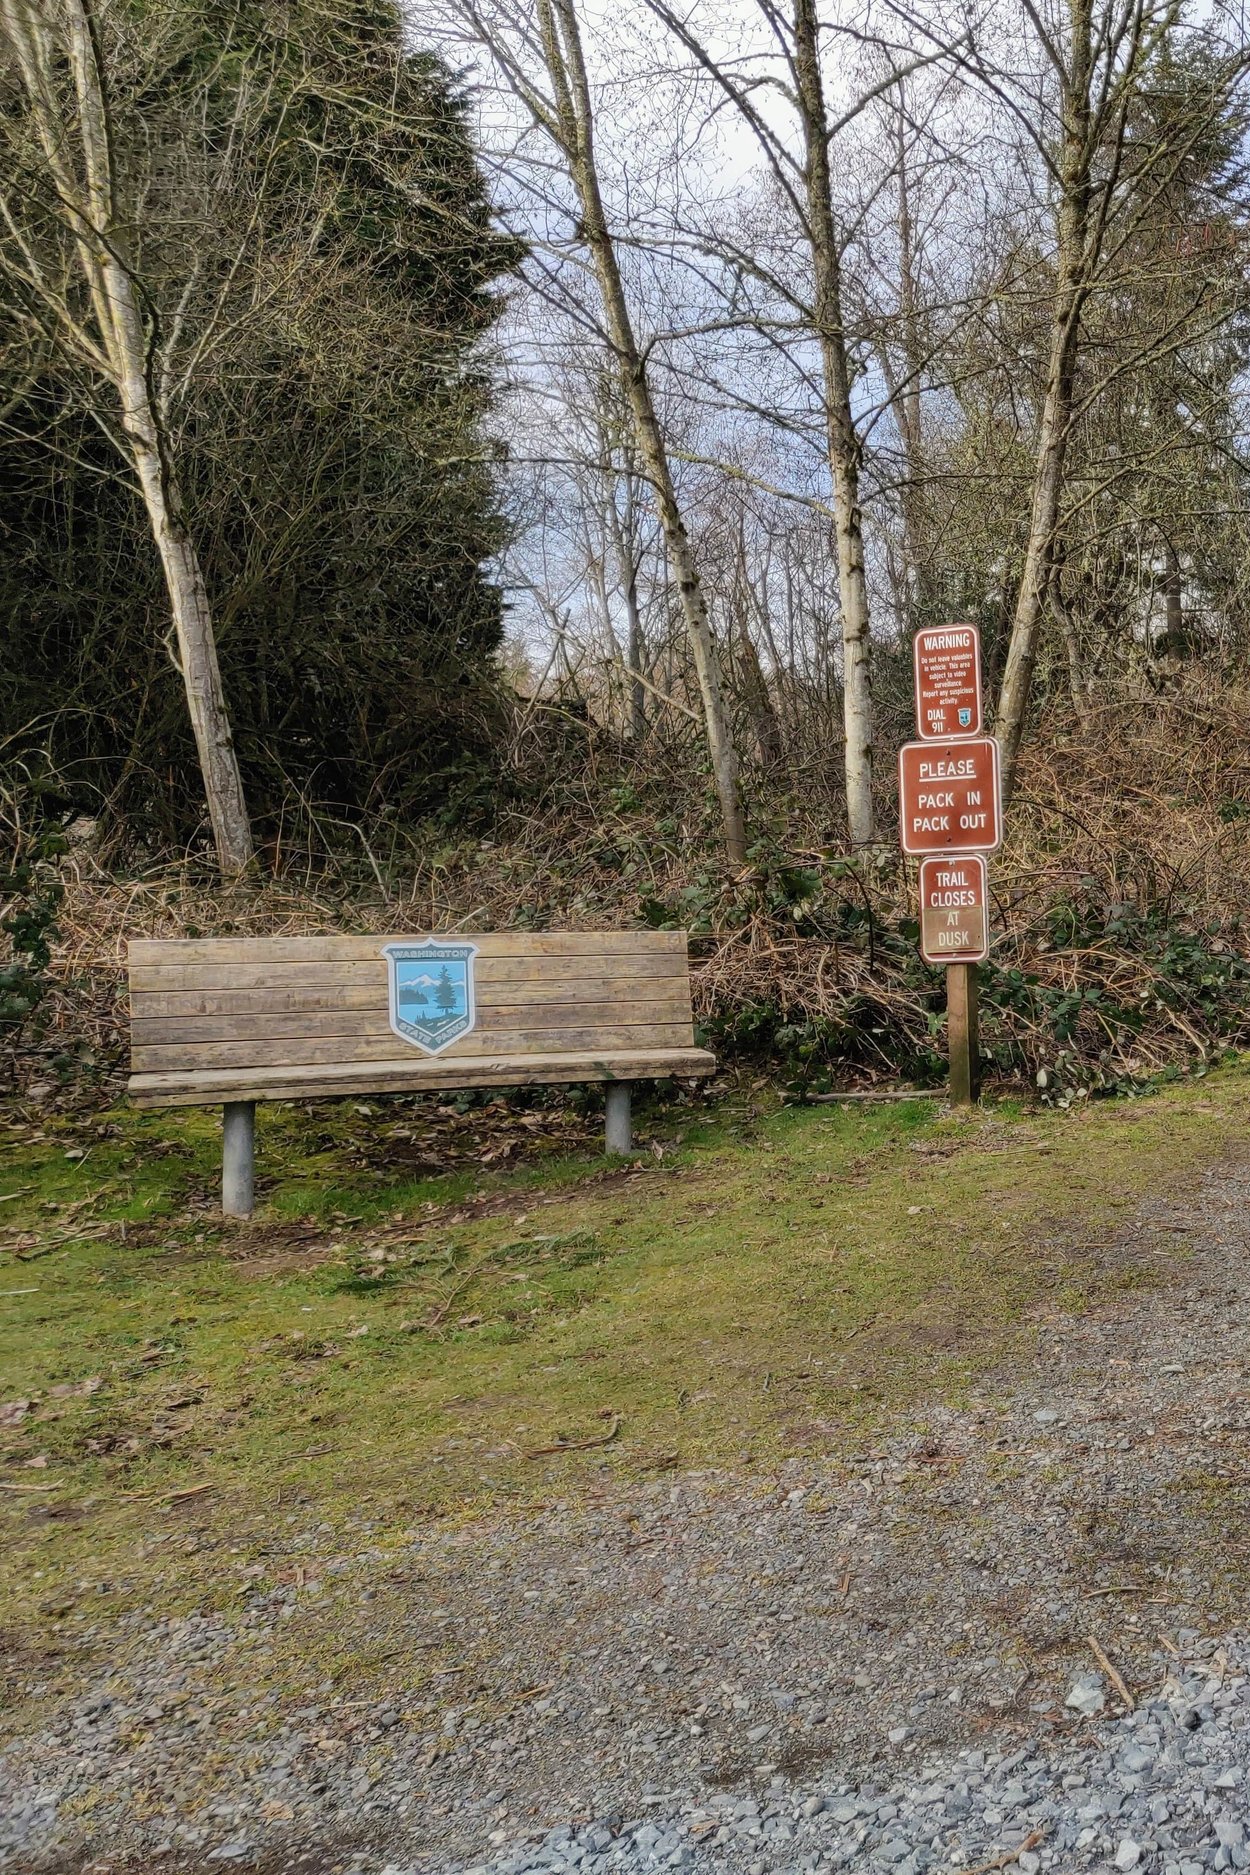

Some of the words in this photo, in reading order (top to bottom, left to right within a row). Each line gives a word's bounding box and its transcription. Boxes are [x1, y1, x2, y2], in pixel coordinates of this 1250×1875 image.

[924, 633, 970, 650] WARNING
[929, 672, 946, 680] subject
[923, 690, 938, 698] Report
[950, 688, 974, 696] suspicious
[928, 709, 946, 720] DIAL
[932, 722, 944, 732] 911
[920, 760, 975, 778] PLEASE
[918, 792, 954, 808] PACK
[966, 791, 980, 806] IN
[914, 816, 950, 832] PACK
[960, 814, 986, 829] OUT
[936, 872, 968, 887] TRAIL
[930, 890, 976, 907] CLOSES
[946, 912, 960, 926] AT
[938, 931, 969, 946] DUSK
[392, 950, 468, 959] WASHINGTON
[398, 1022, 432, 1044] STATE
[434, 1020, 468, 1044] PARKS
